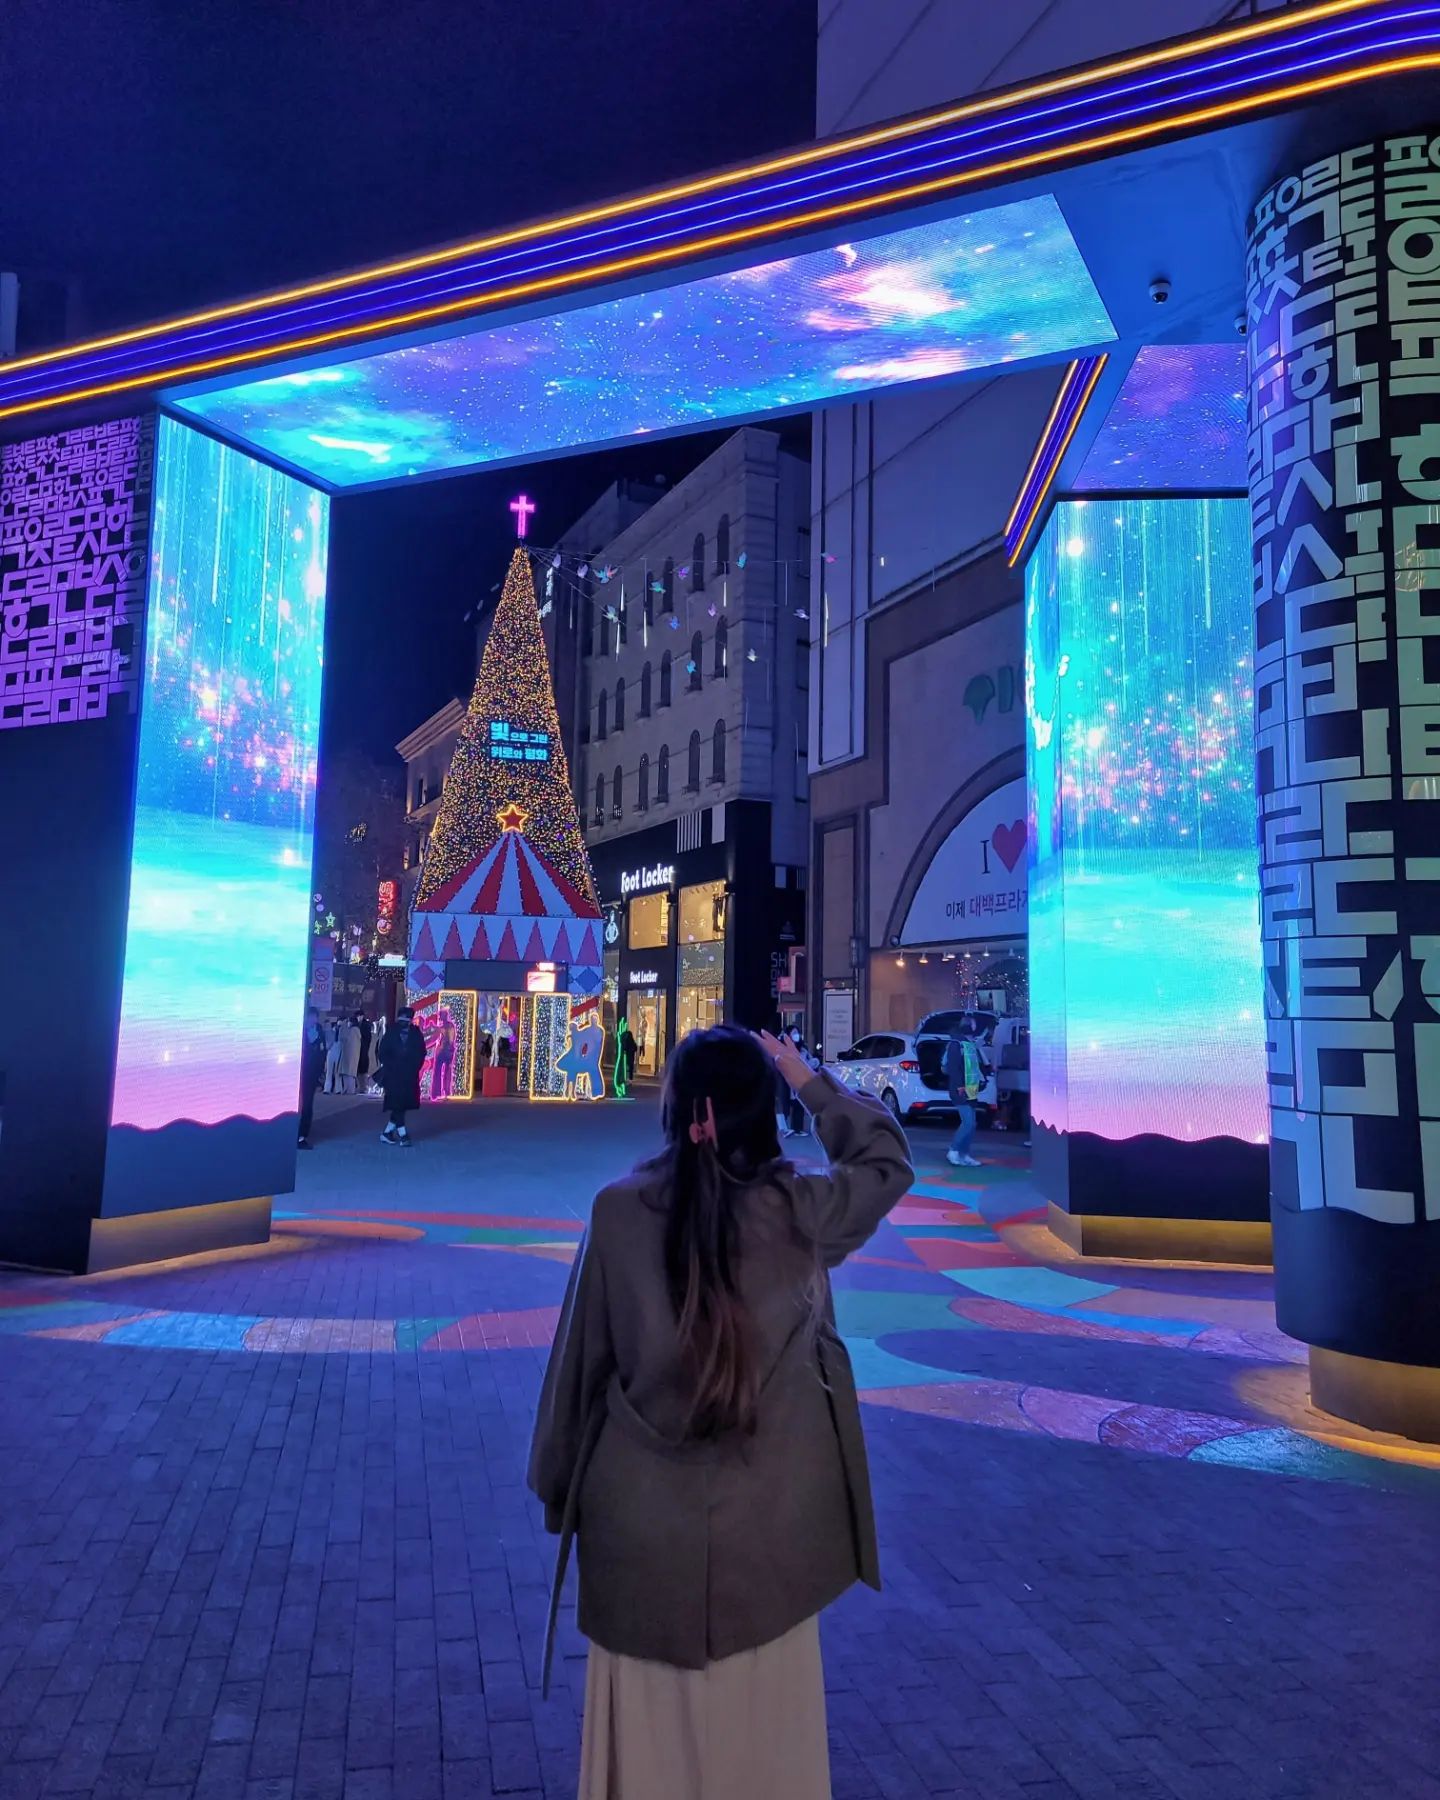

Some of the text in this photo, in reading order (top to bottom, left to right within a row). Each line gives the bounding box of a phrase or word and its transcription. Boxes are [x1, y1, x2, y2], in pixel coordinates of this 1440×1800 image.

[980, 839, 991, 875] I
[621, 862, 675, 894] Foot Locker
[945, 899, 965, 920] 이제
